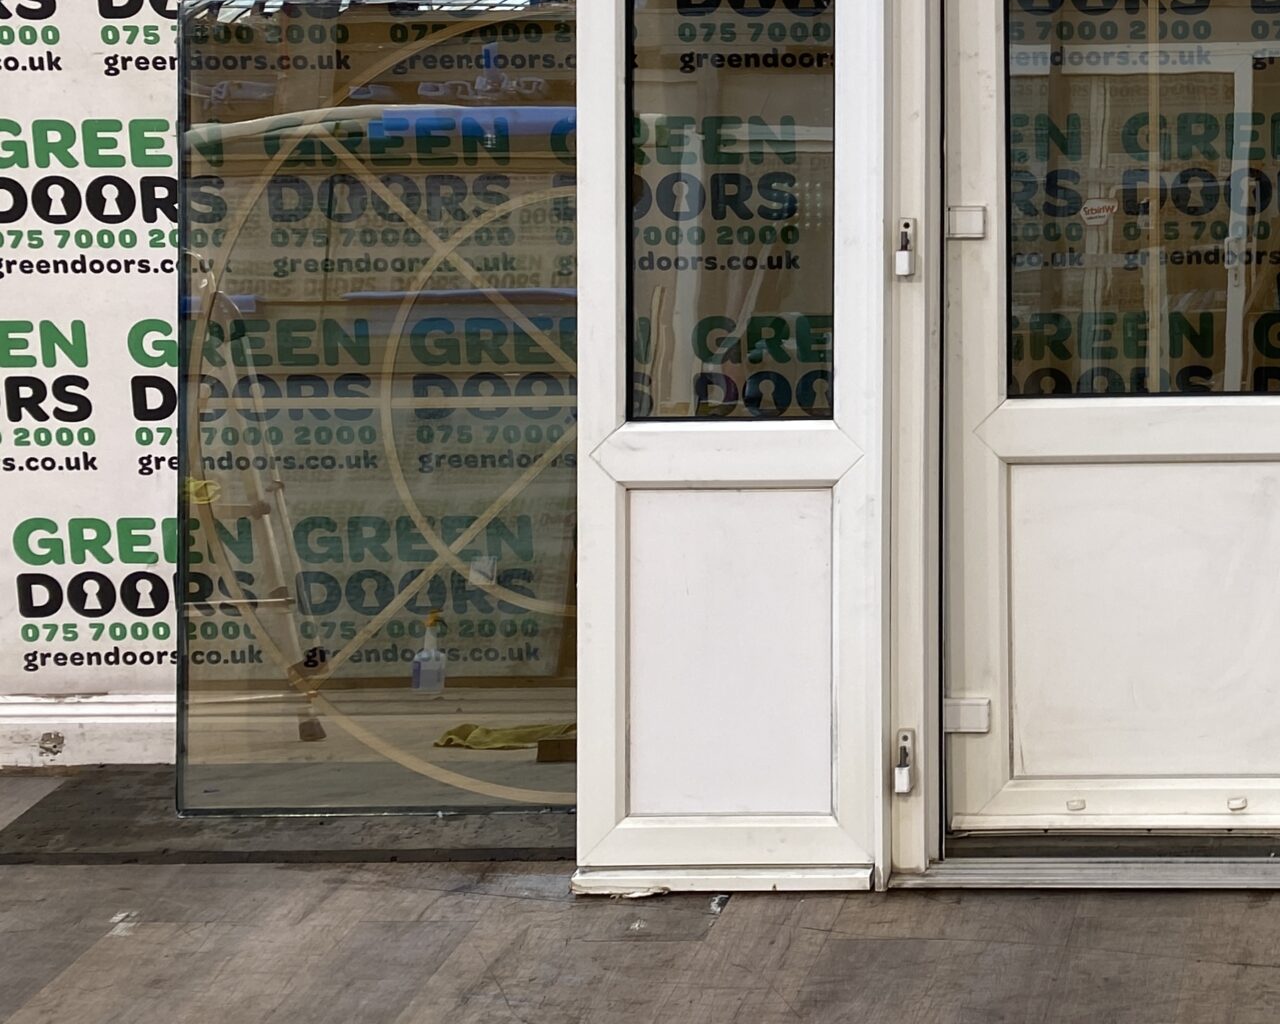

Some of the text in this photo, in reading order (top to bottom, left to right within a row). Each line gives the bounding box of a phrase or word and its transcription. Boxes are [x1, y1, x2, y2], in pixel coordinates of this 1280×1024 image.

[101, 25, 160, 45] 075
[56, 229, 137, 248] 7000
[716, 226, 800, 245] 2000
[14, 427, 95, 446] 2000
[21, 622, 170, 642] 075 7000
